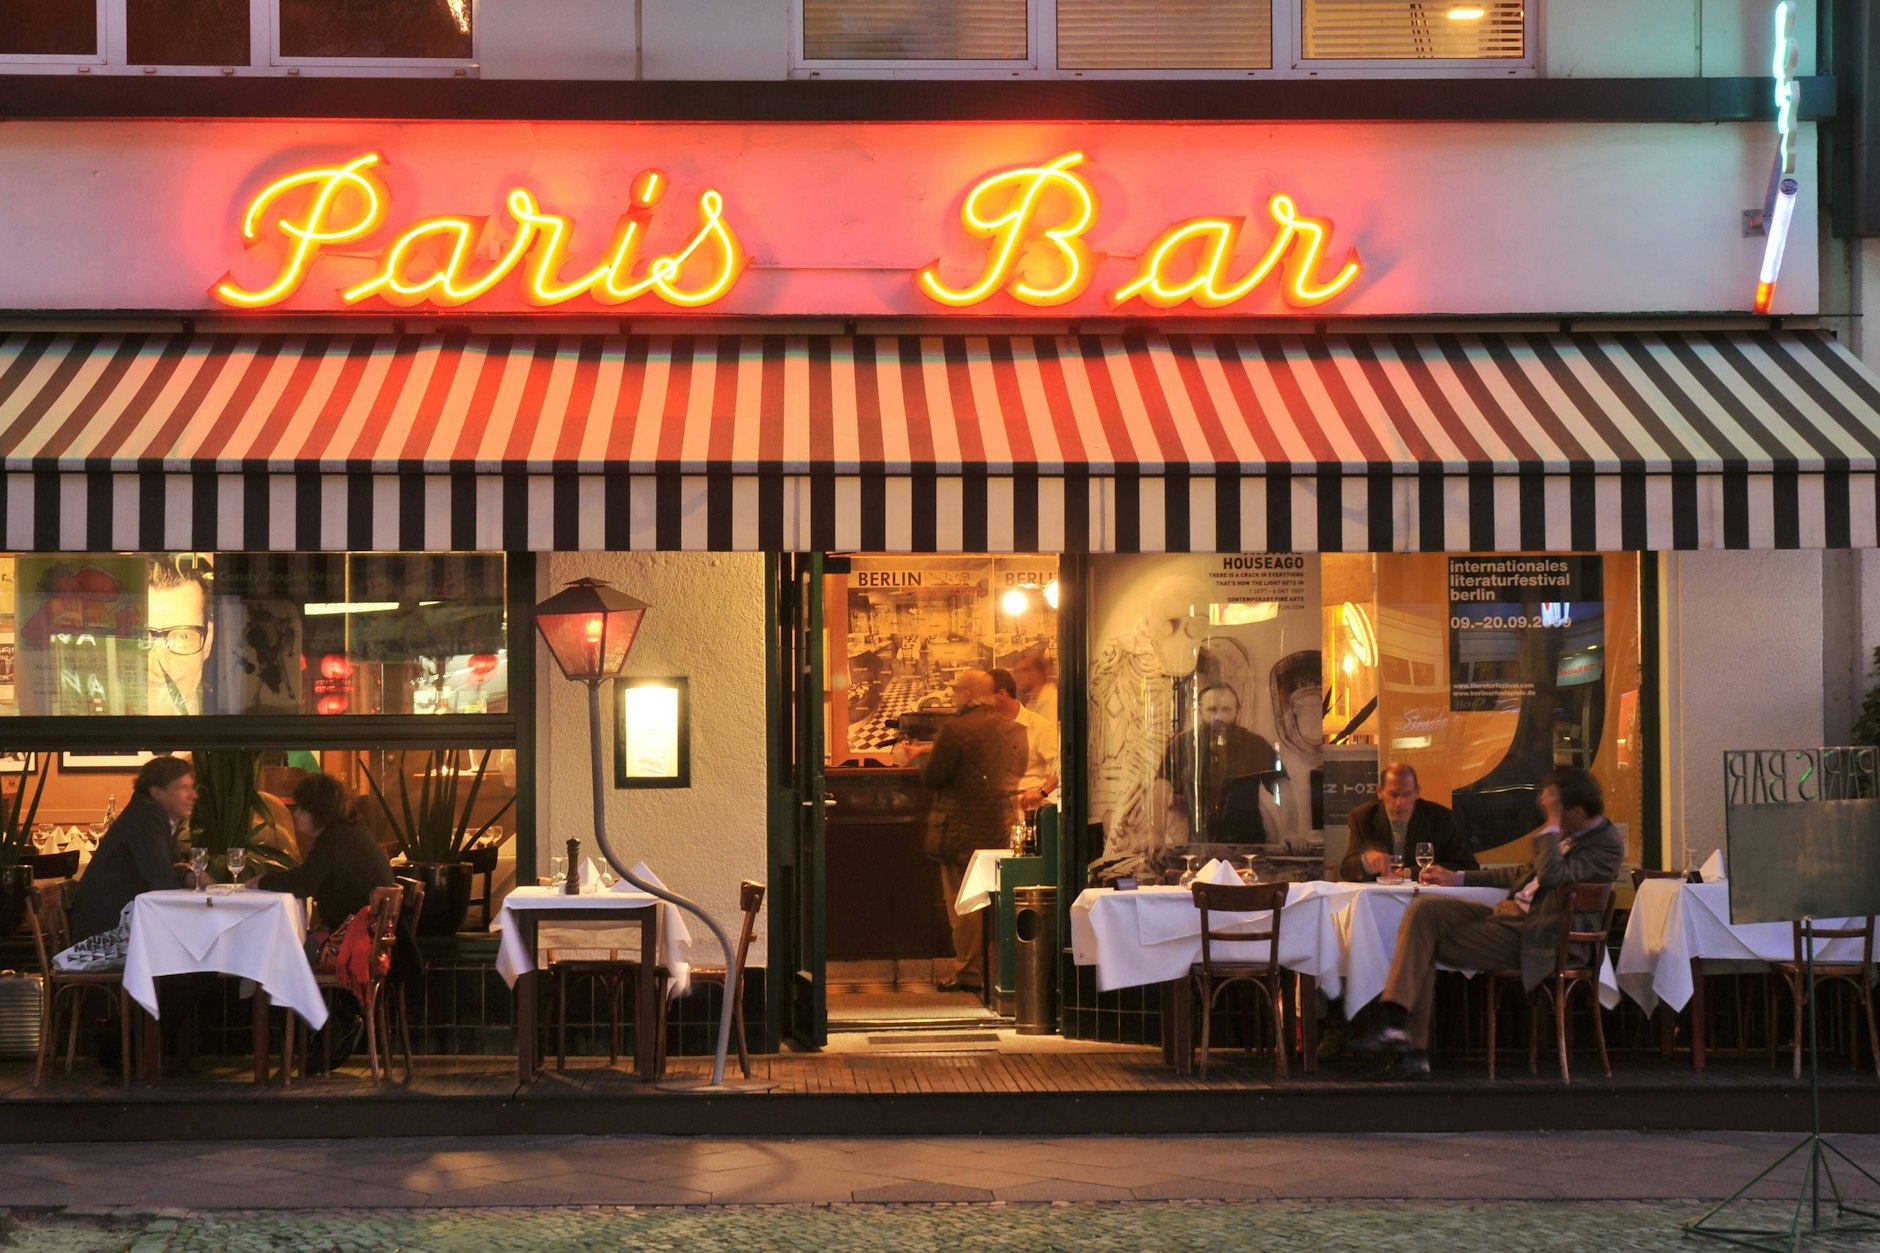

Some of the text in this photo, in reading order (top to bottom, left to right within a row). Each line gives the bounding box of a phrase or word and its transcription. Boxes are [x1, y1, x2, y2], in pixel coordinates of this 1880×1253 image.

[205, 150, 1363, 308] Paris Bar
[1223, 557, 1304, 569] HOUSEAGO
[1450, 560, 1568, 573] internationales
[858, 572, 922, 586] BERLIN
[1450, 574, 1570, 587] literaturfestival
[1450, 588, 1496, 601] berlin
